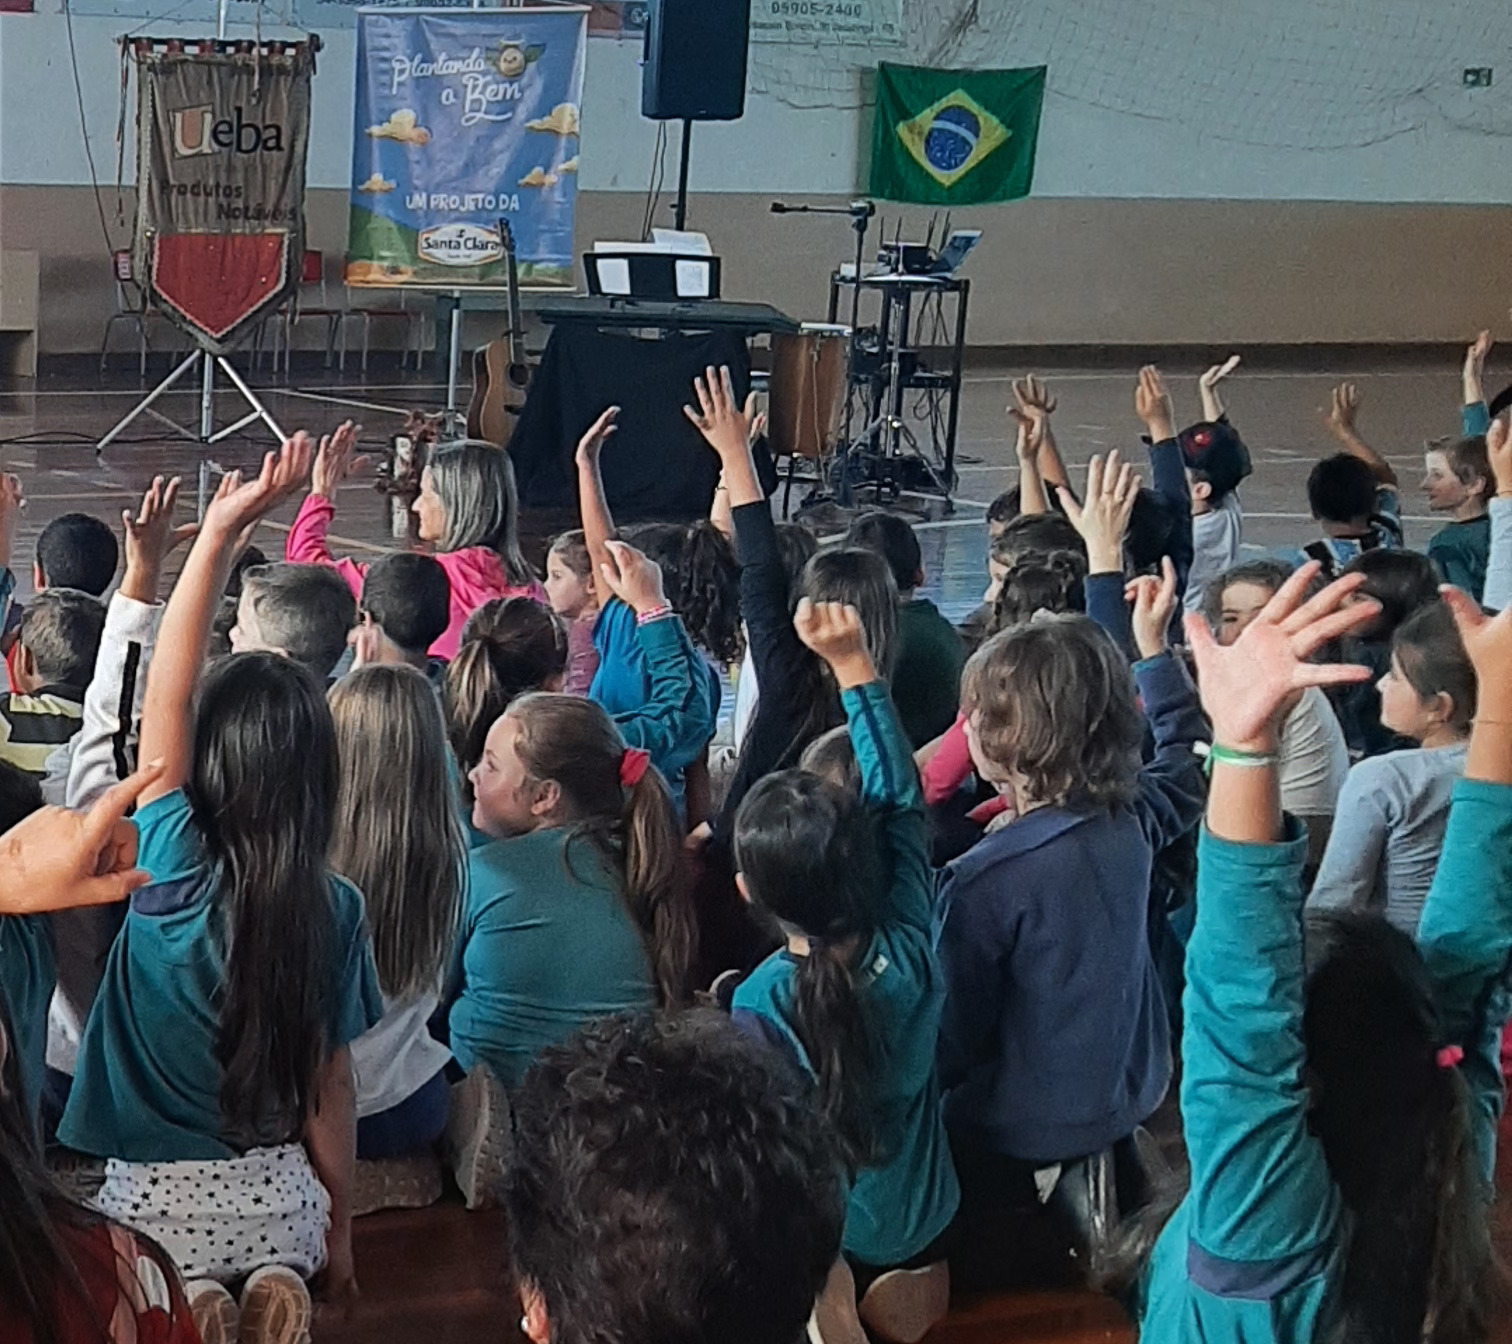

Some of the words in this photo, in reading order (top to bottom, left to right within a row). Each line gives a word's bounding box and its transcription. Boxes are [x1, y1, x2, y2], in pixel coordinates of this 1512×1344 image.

[391, 46, 486, 95] Plantando
[461, 73, 522, 126] Bem
[159, 179, 244, 199] Produtos
[405, 191, 428, 210] UM
[430, 193, 497, 212] PROJETO
[498, 194, 521, 211] DA
[421, 235, 462, 251] Santa
[462, 235, 499, 251] Clara
